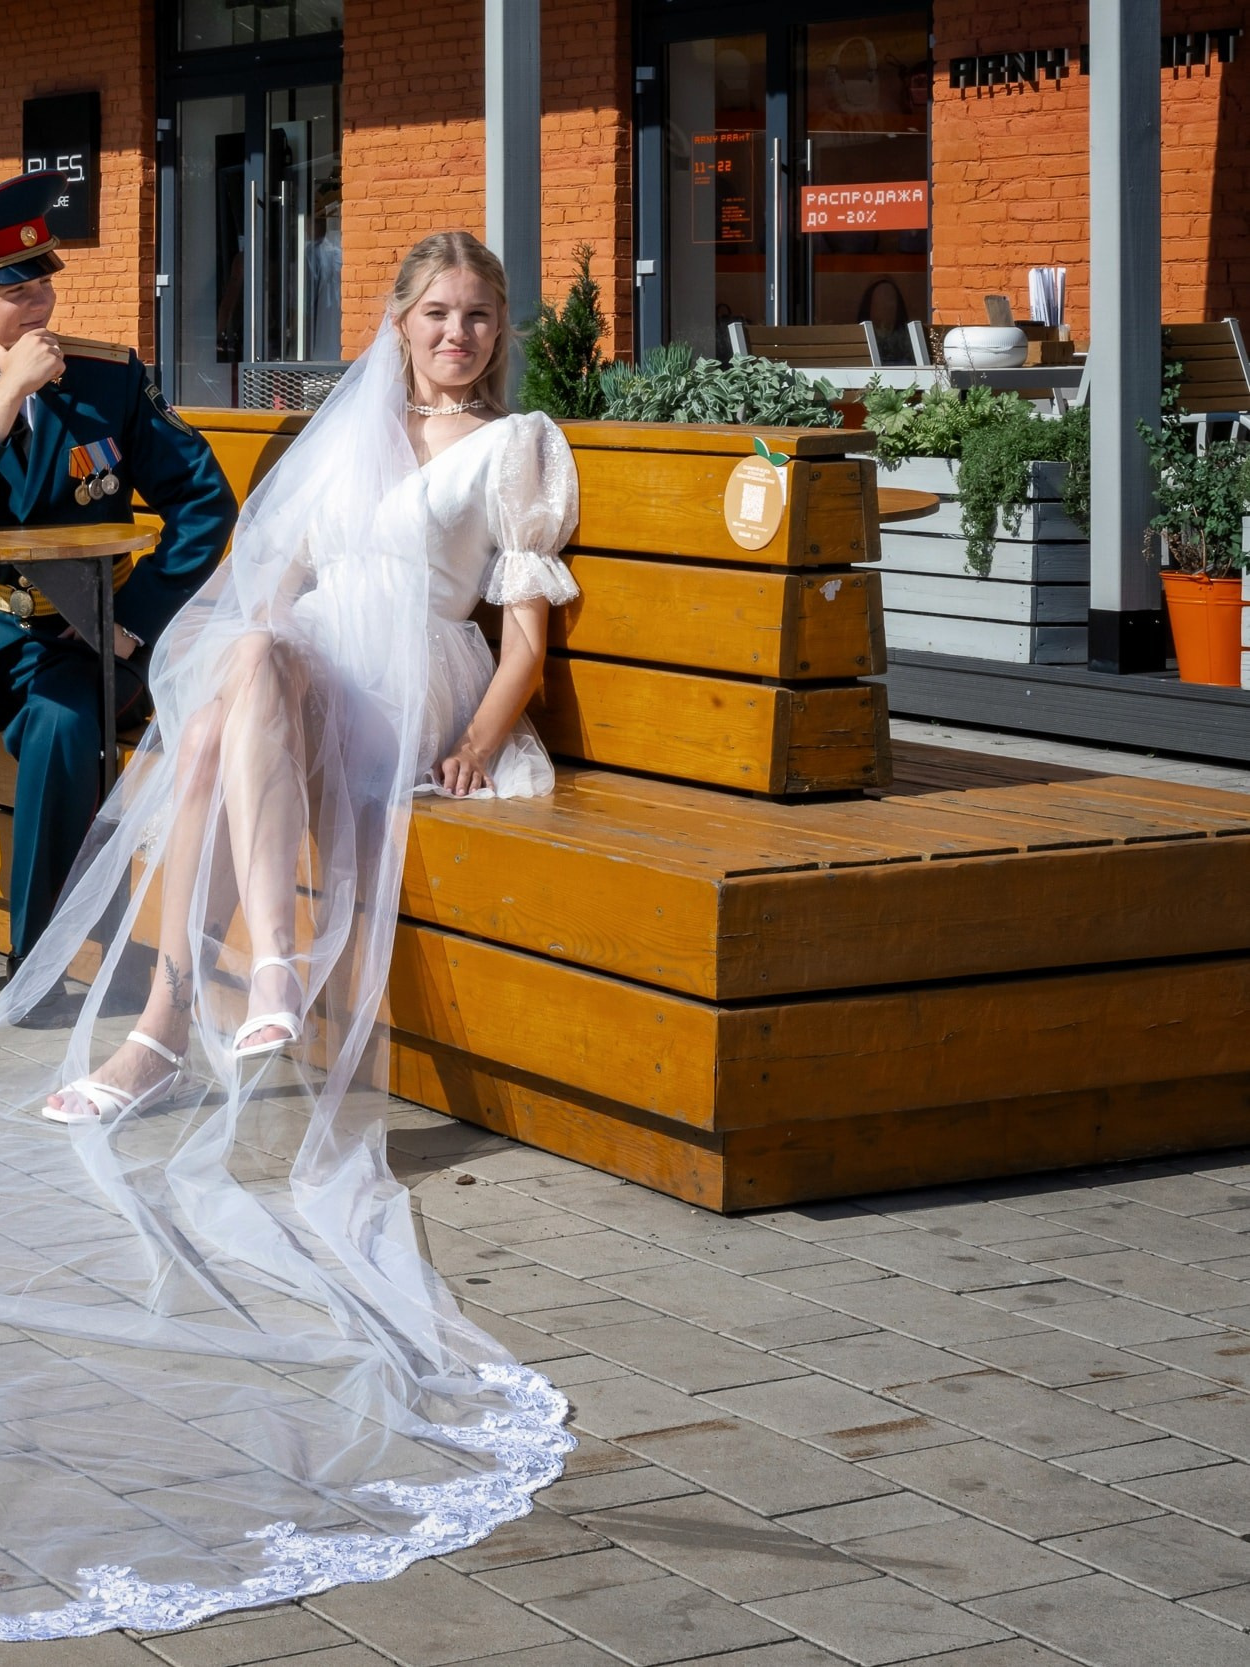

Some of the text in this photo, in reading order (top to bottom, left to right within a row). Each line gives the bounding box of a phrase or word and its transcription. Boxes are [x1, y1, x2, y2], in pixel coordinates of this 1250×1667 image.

[806, 188, 923, 206] РАСПРОДАЖА
[806, 210, 877, 227] ДО -20%
